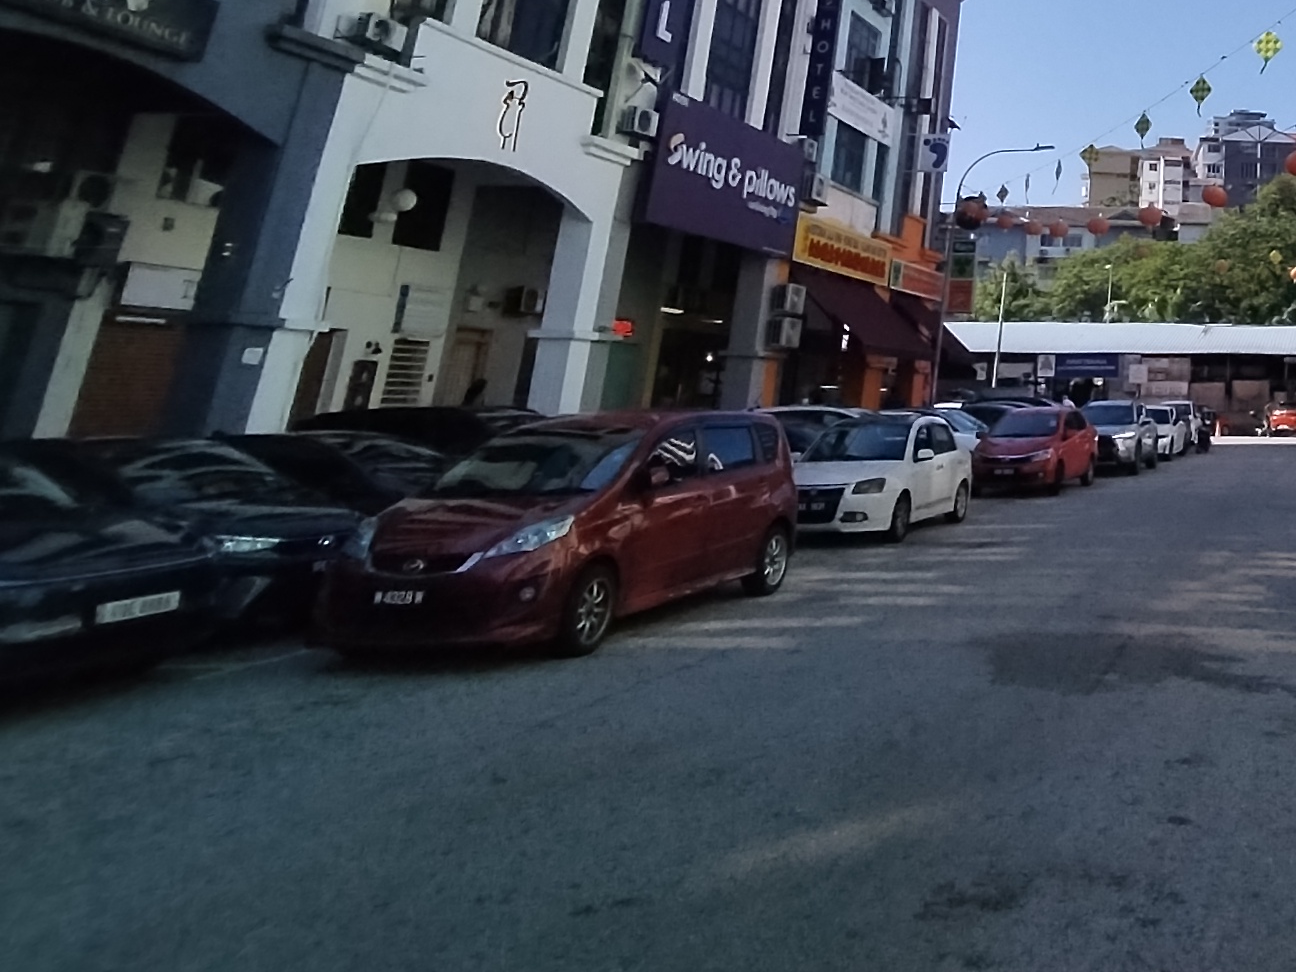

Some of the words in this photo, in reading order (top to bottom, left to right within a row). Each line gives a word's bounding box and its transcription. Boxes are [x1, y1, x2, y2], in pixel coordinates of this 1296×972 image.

[105, 6, 192, 45] LOUNGE
[809, 18, 831, 123] HOTEL
[667, 132, 727, 189] Swing
[728, 157, 742, 187] &
[742, 168, 796, 207] pillows
